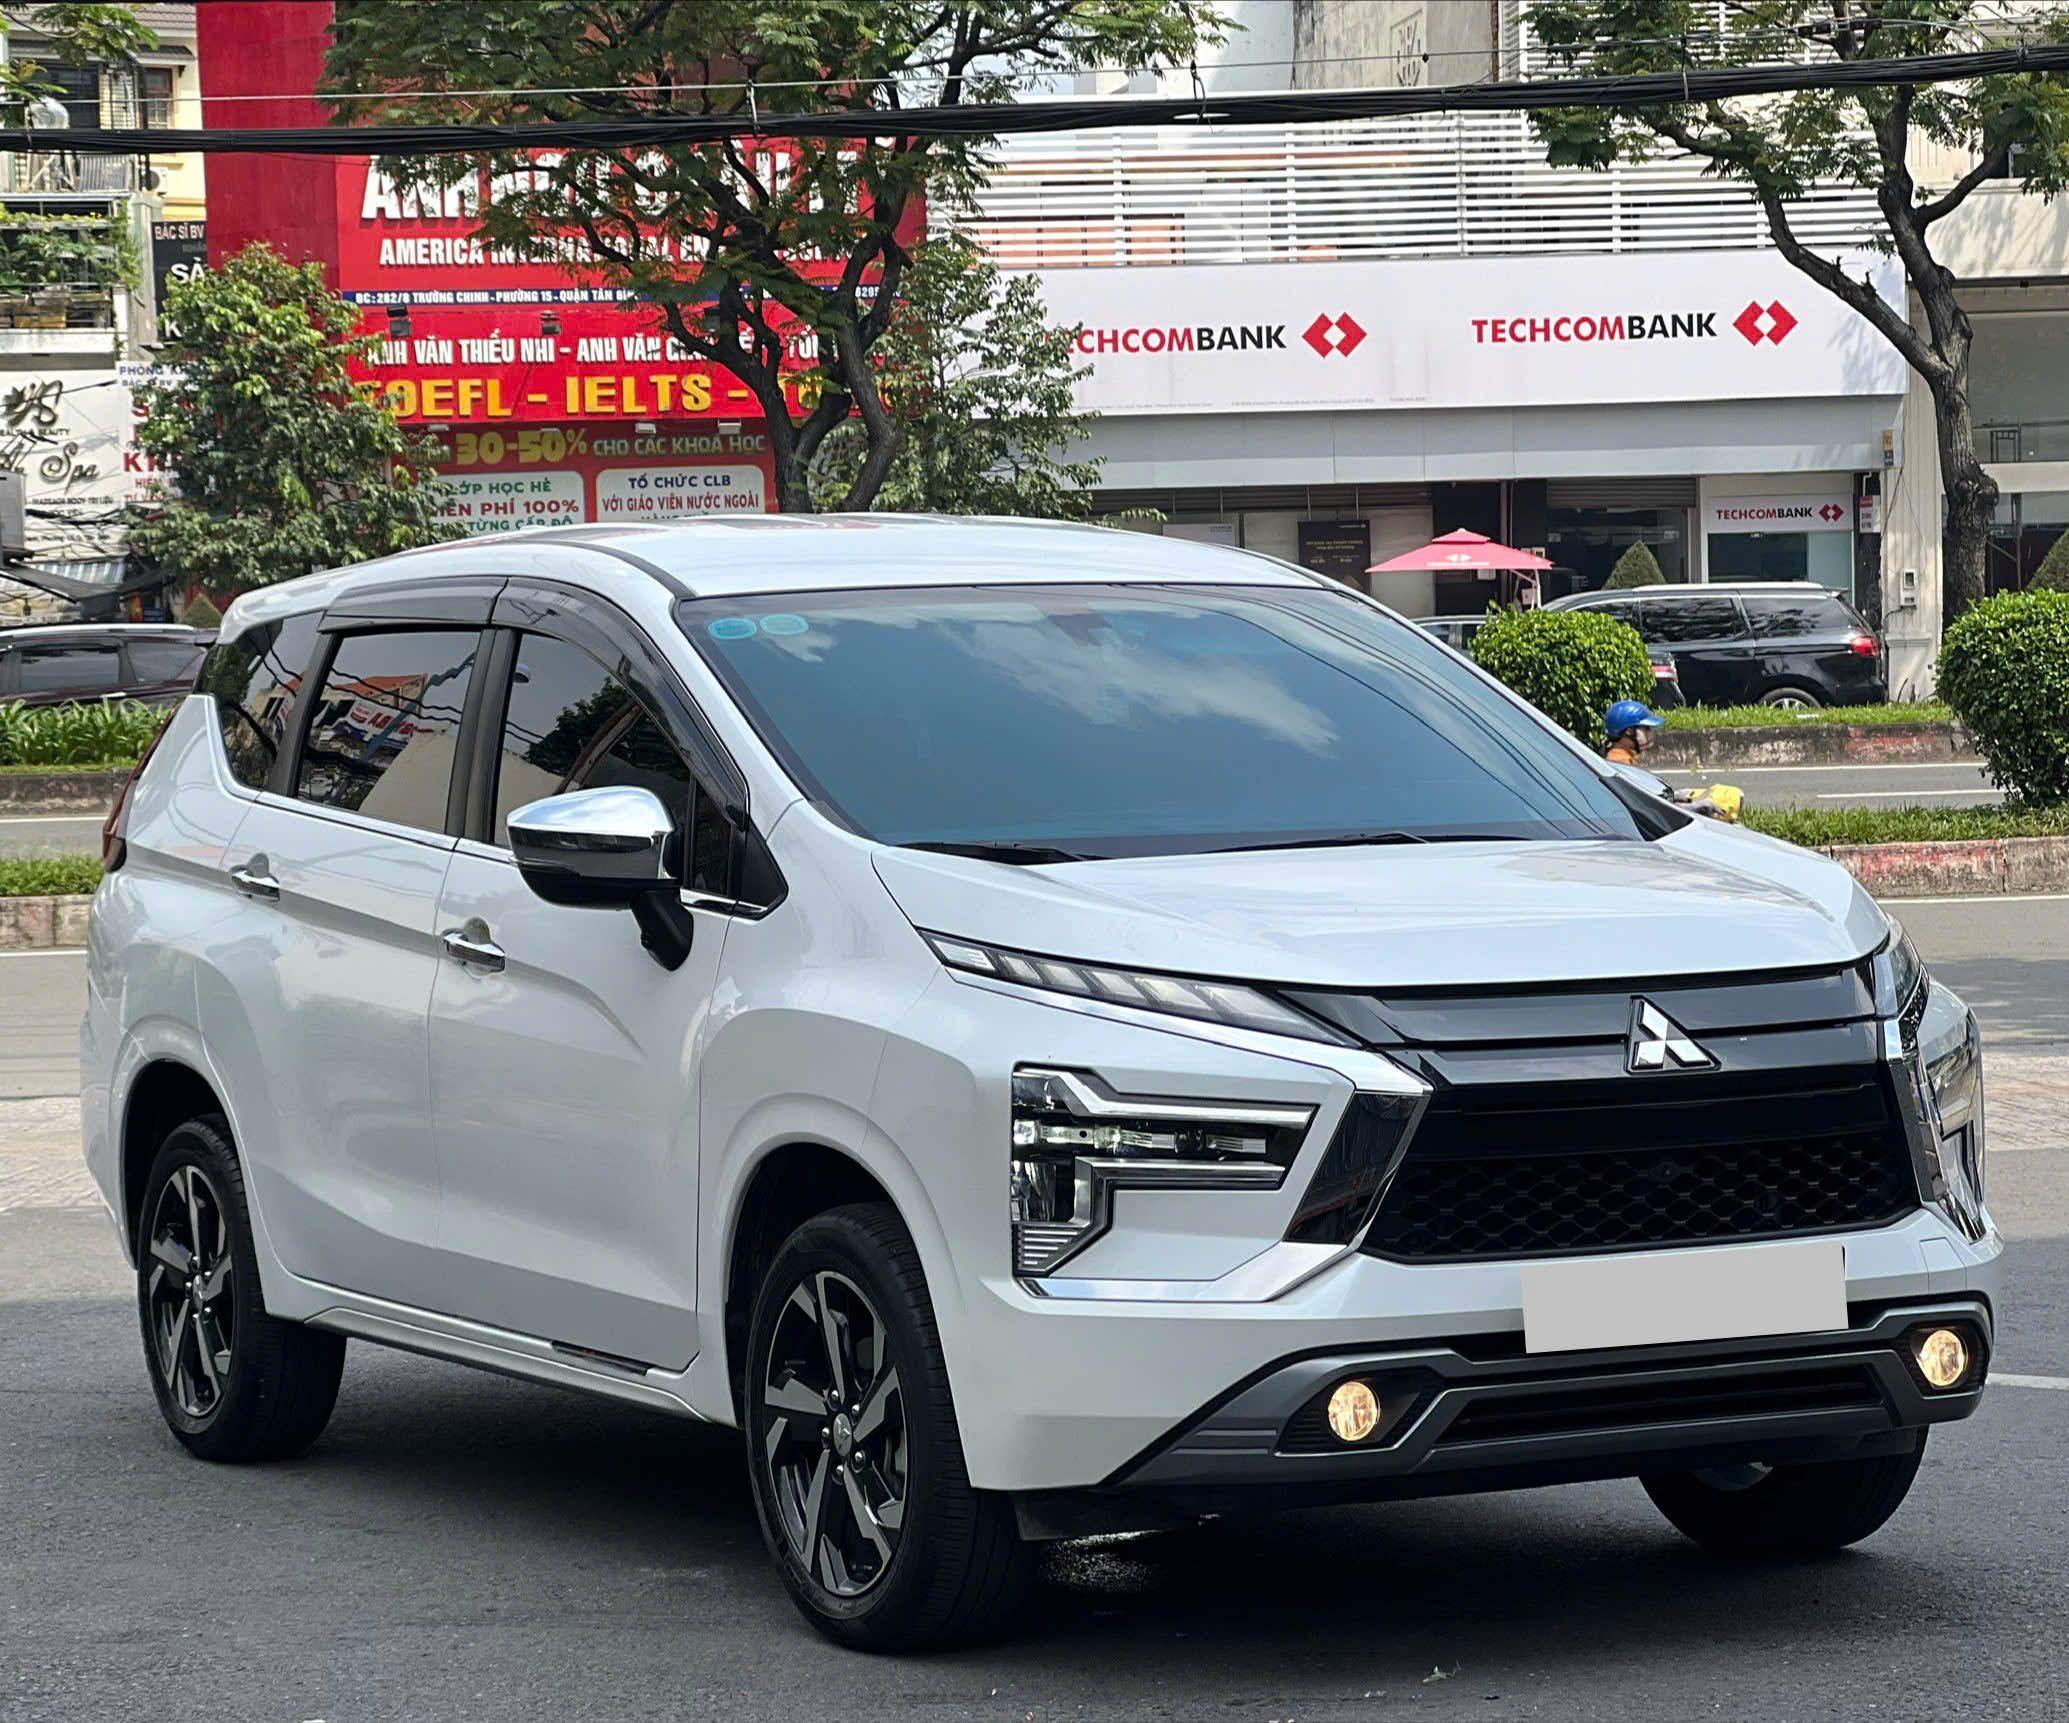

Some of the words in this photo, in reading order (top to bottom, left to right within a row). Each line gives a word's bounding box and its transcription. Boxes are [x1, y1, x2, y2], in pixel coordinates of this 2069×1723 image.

[190, 224, 204, 239] BV
[380, 237, 484, 265] AMERICA
[412, 289, 454, 303] TRƯỜNG
[496, 288, 538, 302] PHƯỜNG
[541, 291, 552, 301] 15
[559, 288, 588, 303] QUẬN
[592, 288, 613, 301] TÂN
[1471, 312, 1718, 344] TECHCOMBANK
[414, 335, 453, 365] VĂN
[521, 338, 555, 363] NHI
[577, 337, 618, 363] ANH
[622, 333, 661, 361] VĂN
[354, 377, 512, 417] TOEFL
[565, 374, 712, 414] IELTS
[456, 428, 588, 465] 30-50%
[593, 439, 630, 457] CHO
[634, 434, 667, 456] CÁC
[729, 435, 766, 456] HỌC
[40, 442, 99, 495] Spa
[489, 482, 524, 496] HỌC
[531, 477, 552, 492] HÈ
[654, 473, 698, 488] CHỨC
[704, 475, 731, 487] CLB
[481, 498, 515, 516] PHÍ
[523, 499, 580, 515] 100%
[602, 494, 623, 512] VỚI
[627, 493, 653, 511] GIÁO
[657, 492, 683, 510] VIÊN
[687, 491, 720, 508] NƯỚC
[724, 490, 759, 508] NGOÀI
[1716, 507, 1813, 520] TECHCOMBANK
